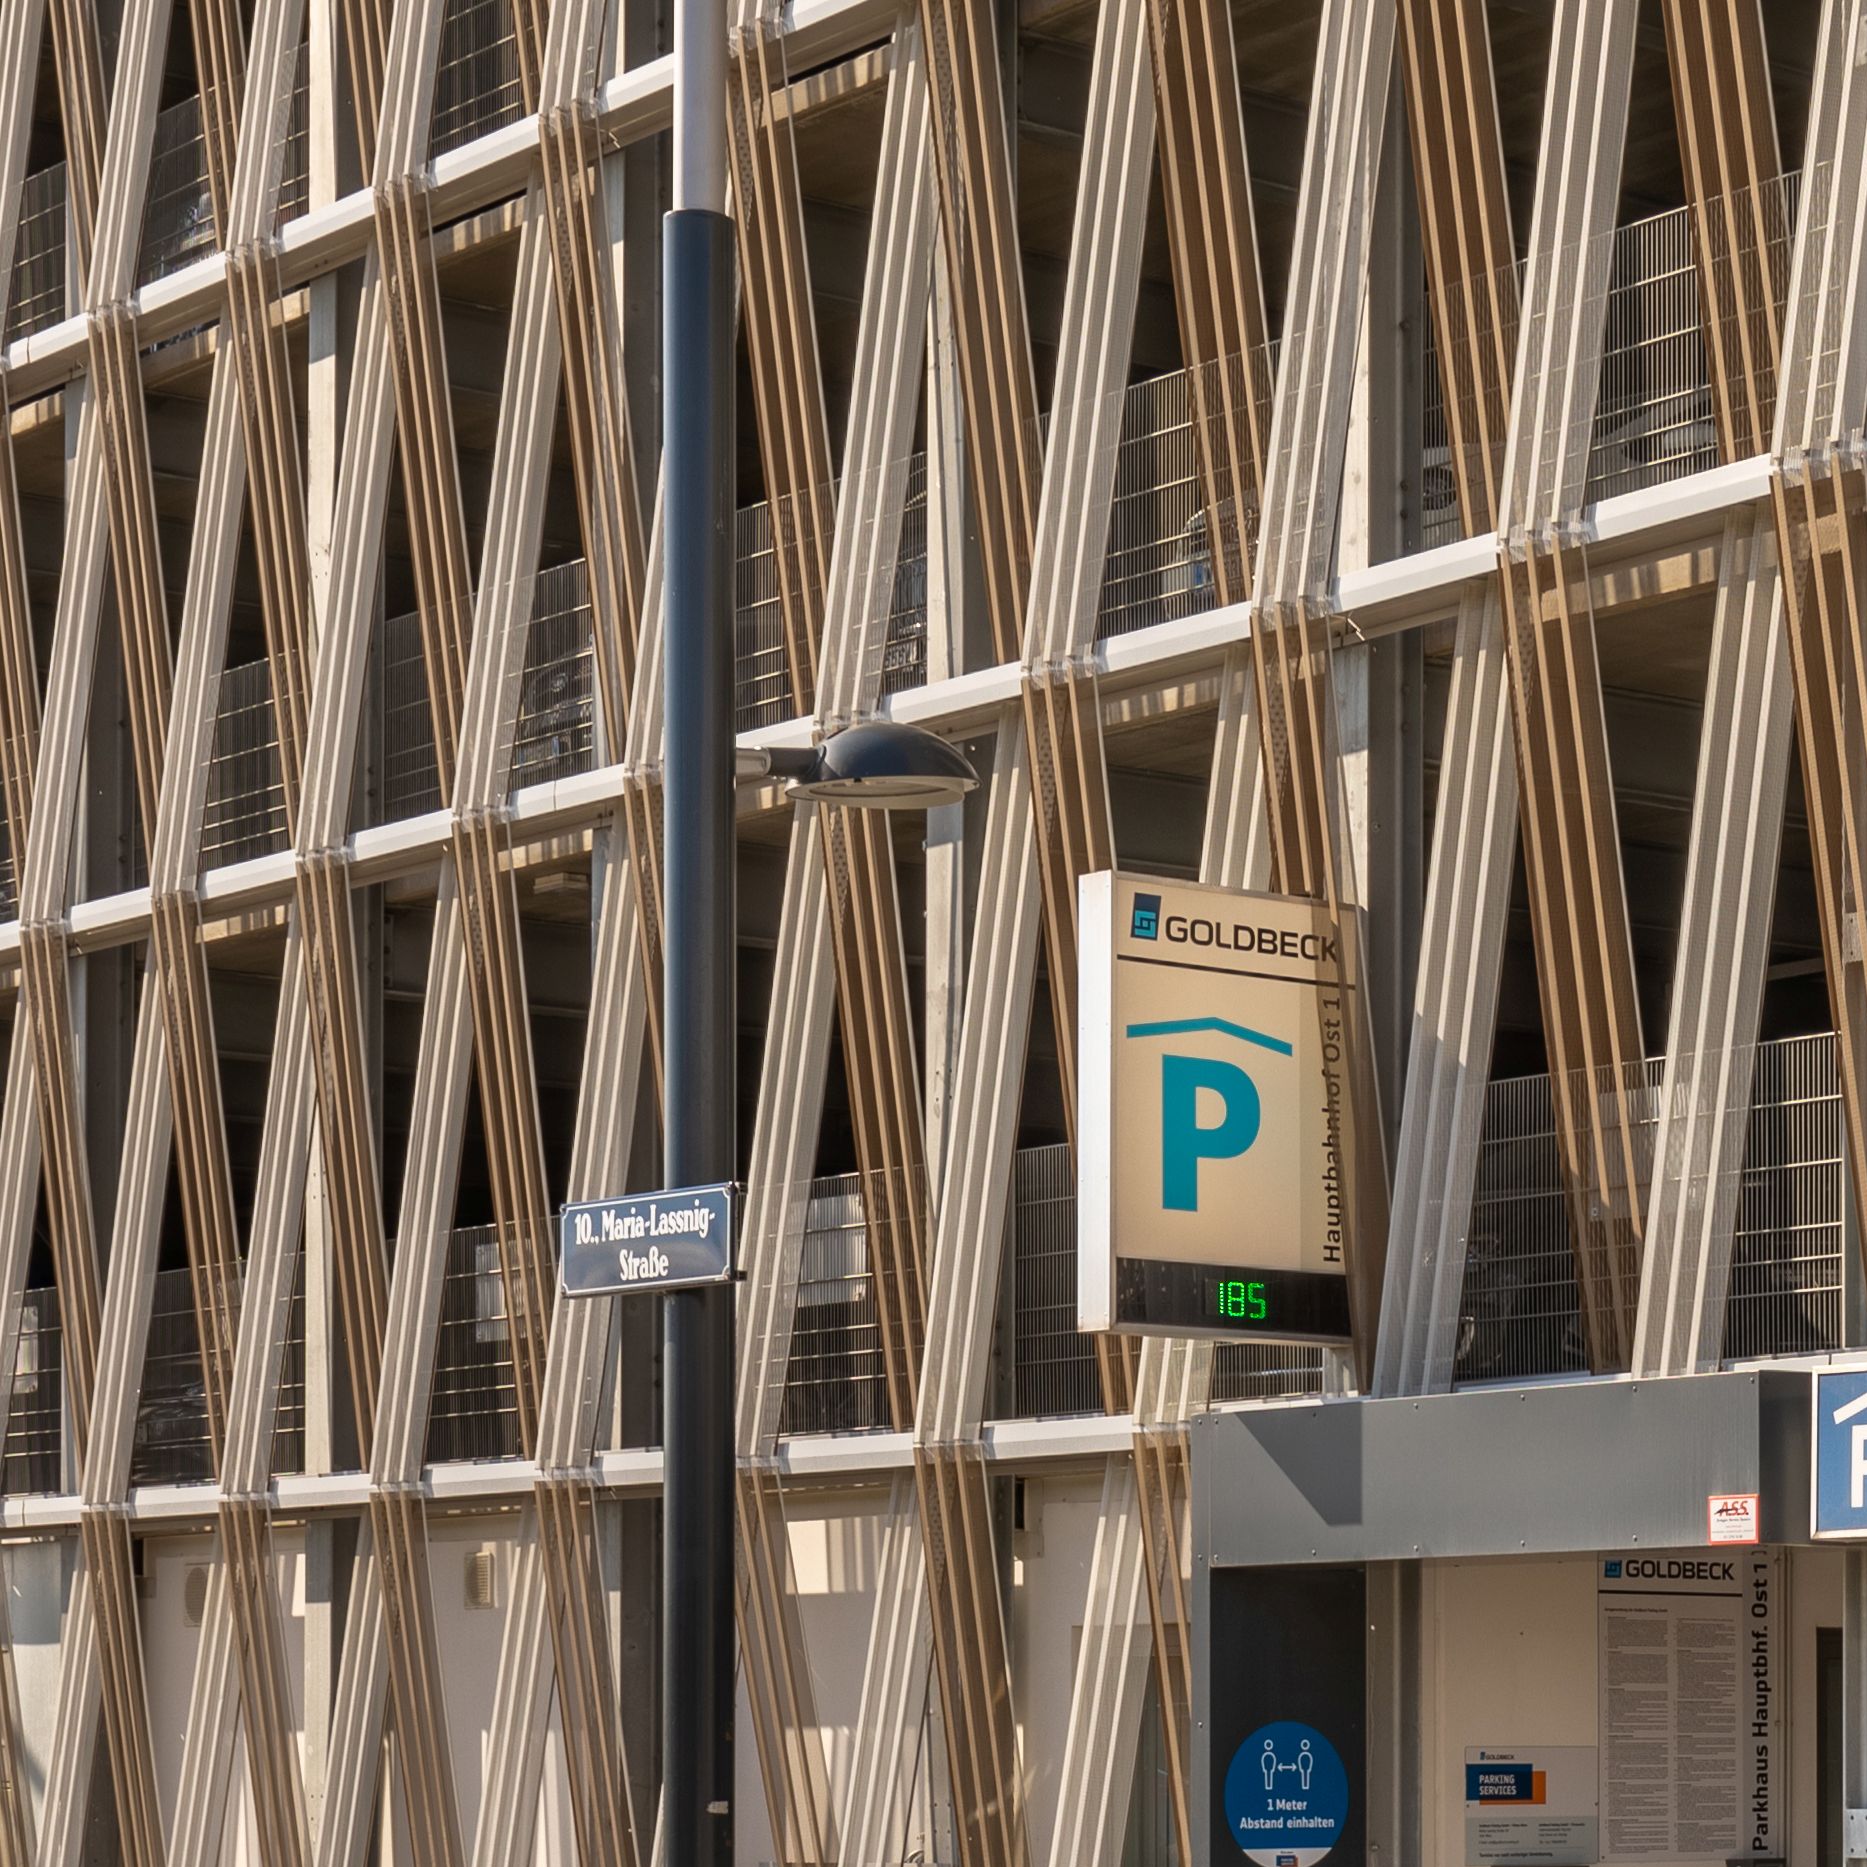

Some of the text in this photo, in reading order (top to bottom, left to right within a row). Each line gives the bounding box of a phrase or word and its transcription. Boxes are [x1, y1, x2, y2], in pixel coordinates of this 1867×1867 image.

[1164, 914, 1339, 963] GOLDBECK
[1162, 1053, 1261, 1212] P
[1321, 997, 1342, 1263] Hauptbahnhof Ost 1
[574, 1198, 716, 1246] 10., Maria-Lassnig-
[619, 1245, 669, 1281] Straße
[1217, 1280, 1266, 1320] 185
[1626, 1559, 1734, 1580] GOLDBECK
[1754, 1563, 1768, 1573] 1
[1751, 1580, 1768, 1618] Ost
[1751, 1626, 1772, 1738] Hauptbhf.
[1479, 1774, 1515, 1784] PARKING
[1479, 1785, 1517, 1796] SERVICES
[1752, 1745, 1768, 1851] Parkhaus
[1240, 1817, 1335, 1829] Abstand einhalten
[1267, 1798, 1308, 1811] 1 Meter
